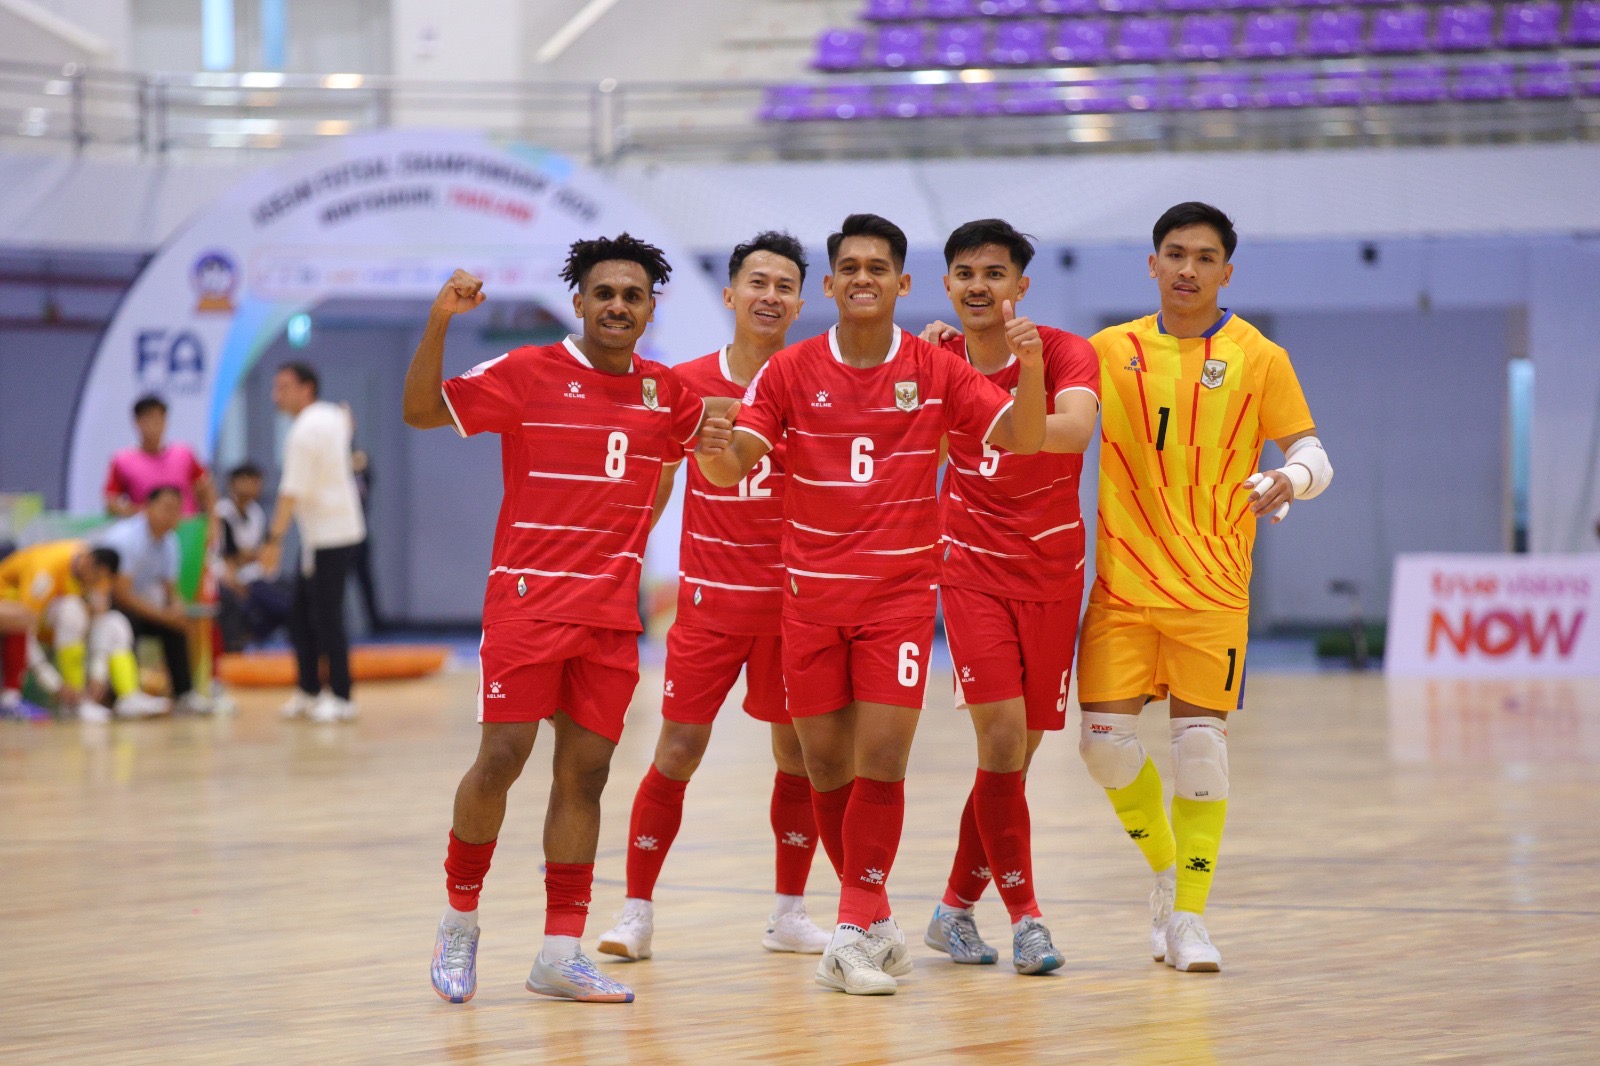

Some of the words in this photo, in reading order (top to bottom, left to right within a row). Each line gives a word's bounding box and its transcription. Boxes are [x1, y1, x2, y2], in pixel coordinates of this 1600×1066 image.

[136, 328, 204, 373] FA
[1156, 406, 1170, 451] 1
[605, 431, 629, 479] 8
[850, 437, 874, 482] 6
[979, 443, 1000, 477] 5
[1427, 609, 1585, 657] NOW
[898, 642, 920, 687] 6
[1224, 648, 1236, 691] 1
[1056, 669, 1068, 712] 5
[1001, 878, 1025, 888] KELME
